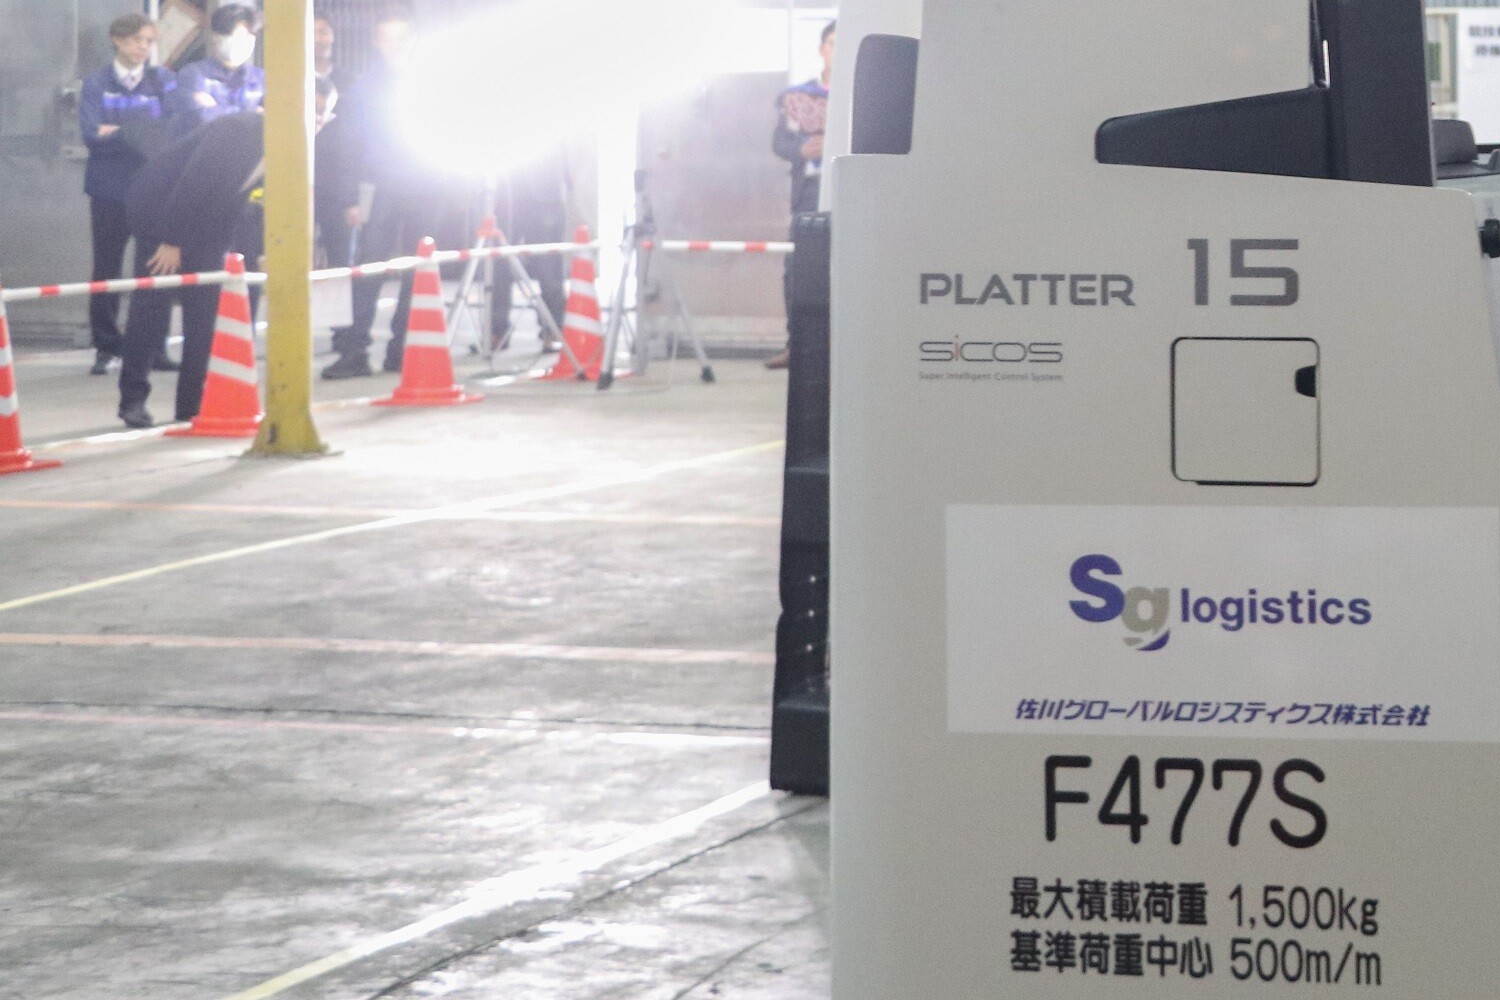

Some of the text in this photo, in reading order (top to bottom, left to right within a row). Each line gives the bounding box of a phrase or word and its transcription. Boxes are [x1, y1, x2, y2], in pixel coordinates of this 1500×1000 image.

[919, 237, 1300, 307] PLATTER 15
[1069, 553, 1373, 652] Sg logistics
[1014, 697, 1431, 727] 佐川グローバルロジスティクス株式会社
[1043, 754, 1328, 849] F477S
[1009, 876, 1380, 936] 最大積載荷重 1,500kg
[1009, 929, 1382, 986] 基準荷重中心 500m/m
